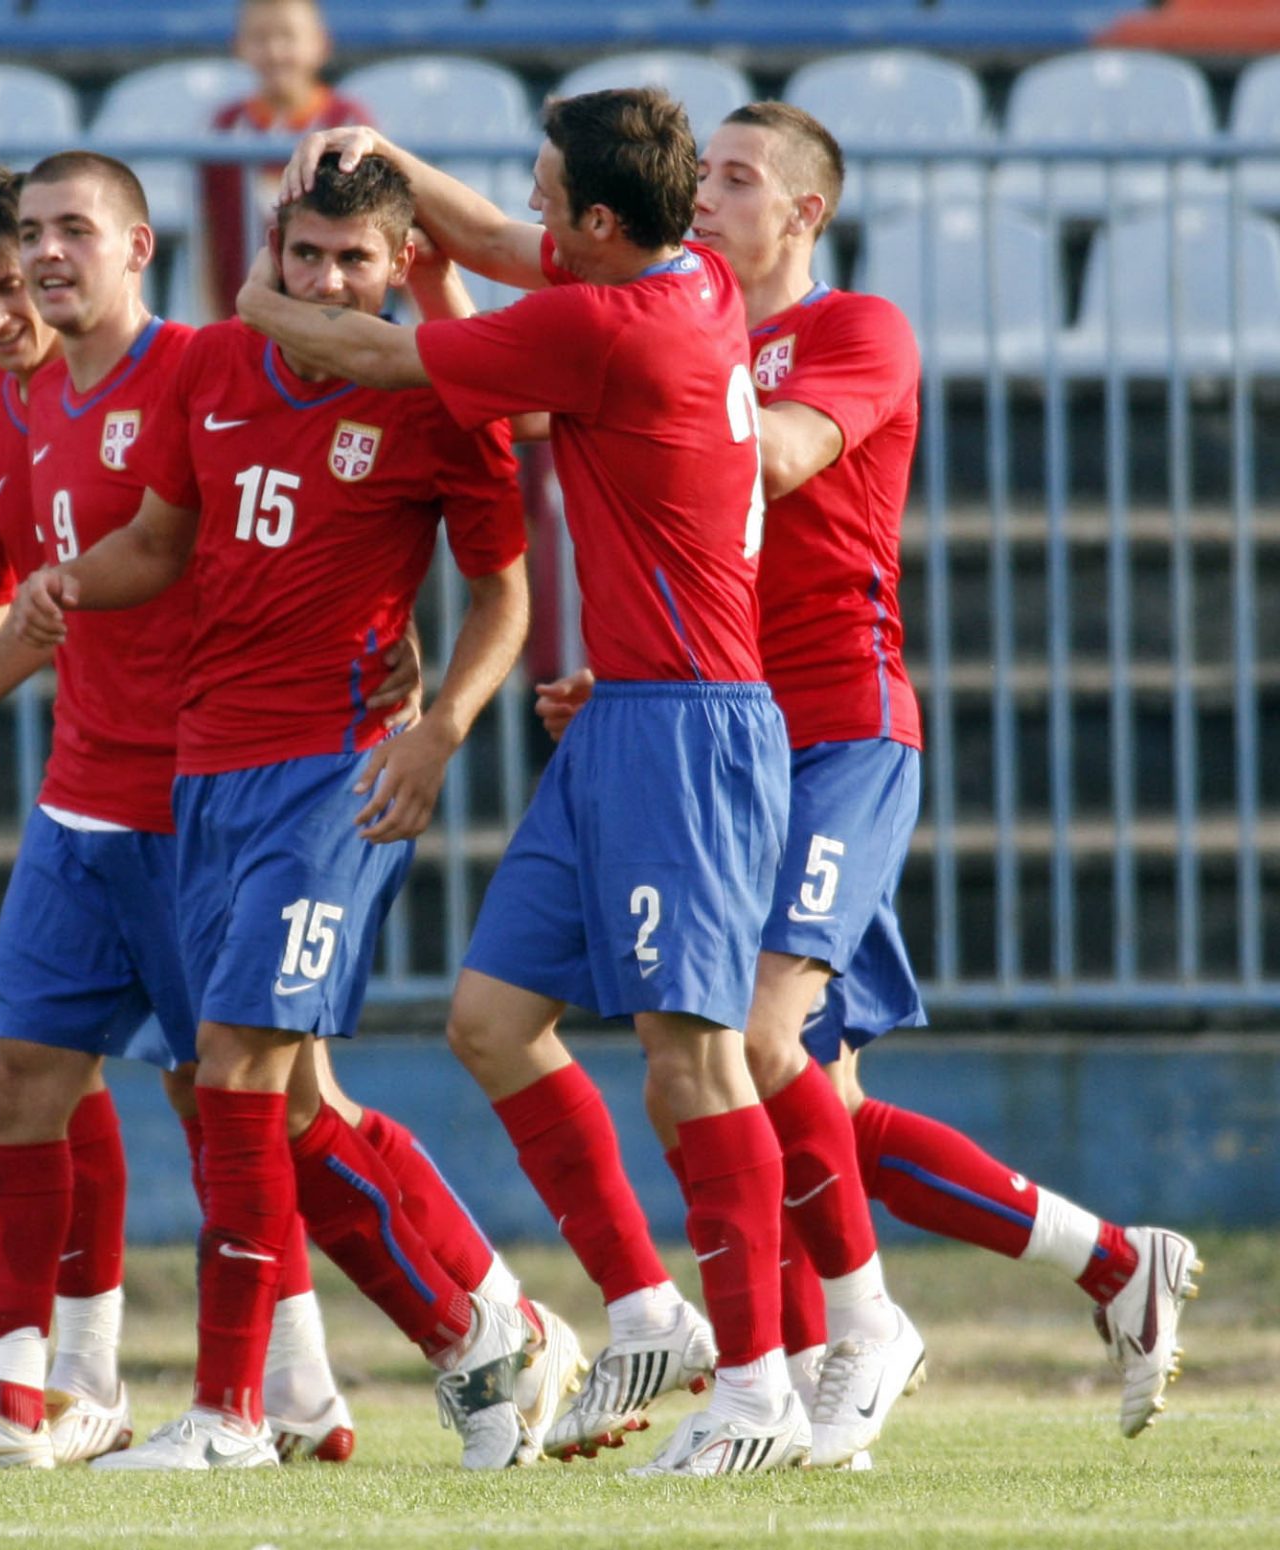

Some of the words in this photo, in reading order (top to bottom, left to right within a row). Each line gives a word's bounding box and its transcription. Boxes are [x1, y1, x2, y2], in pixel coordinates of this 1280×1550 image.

[53, 489, 78, 562] 9
[234, 465, 300, 548] 15
[800, 834, 844, 912] 5
[281, 898, 343, 979] 15
[630, 885, 660, 961] 2
